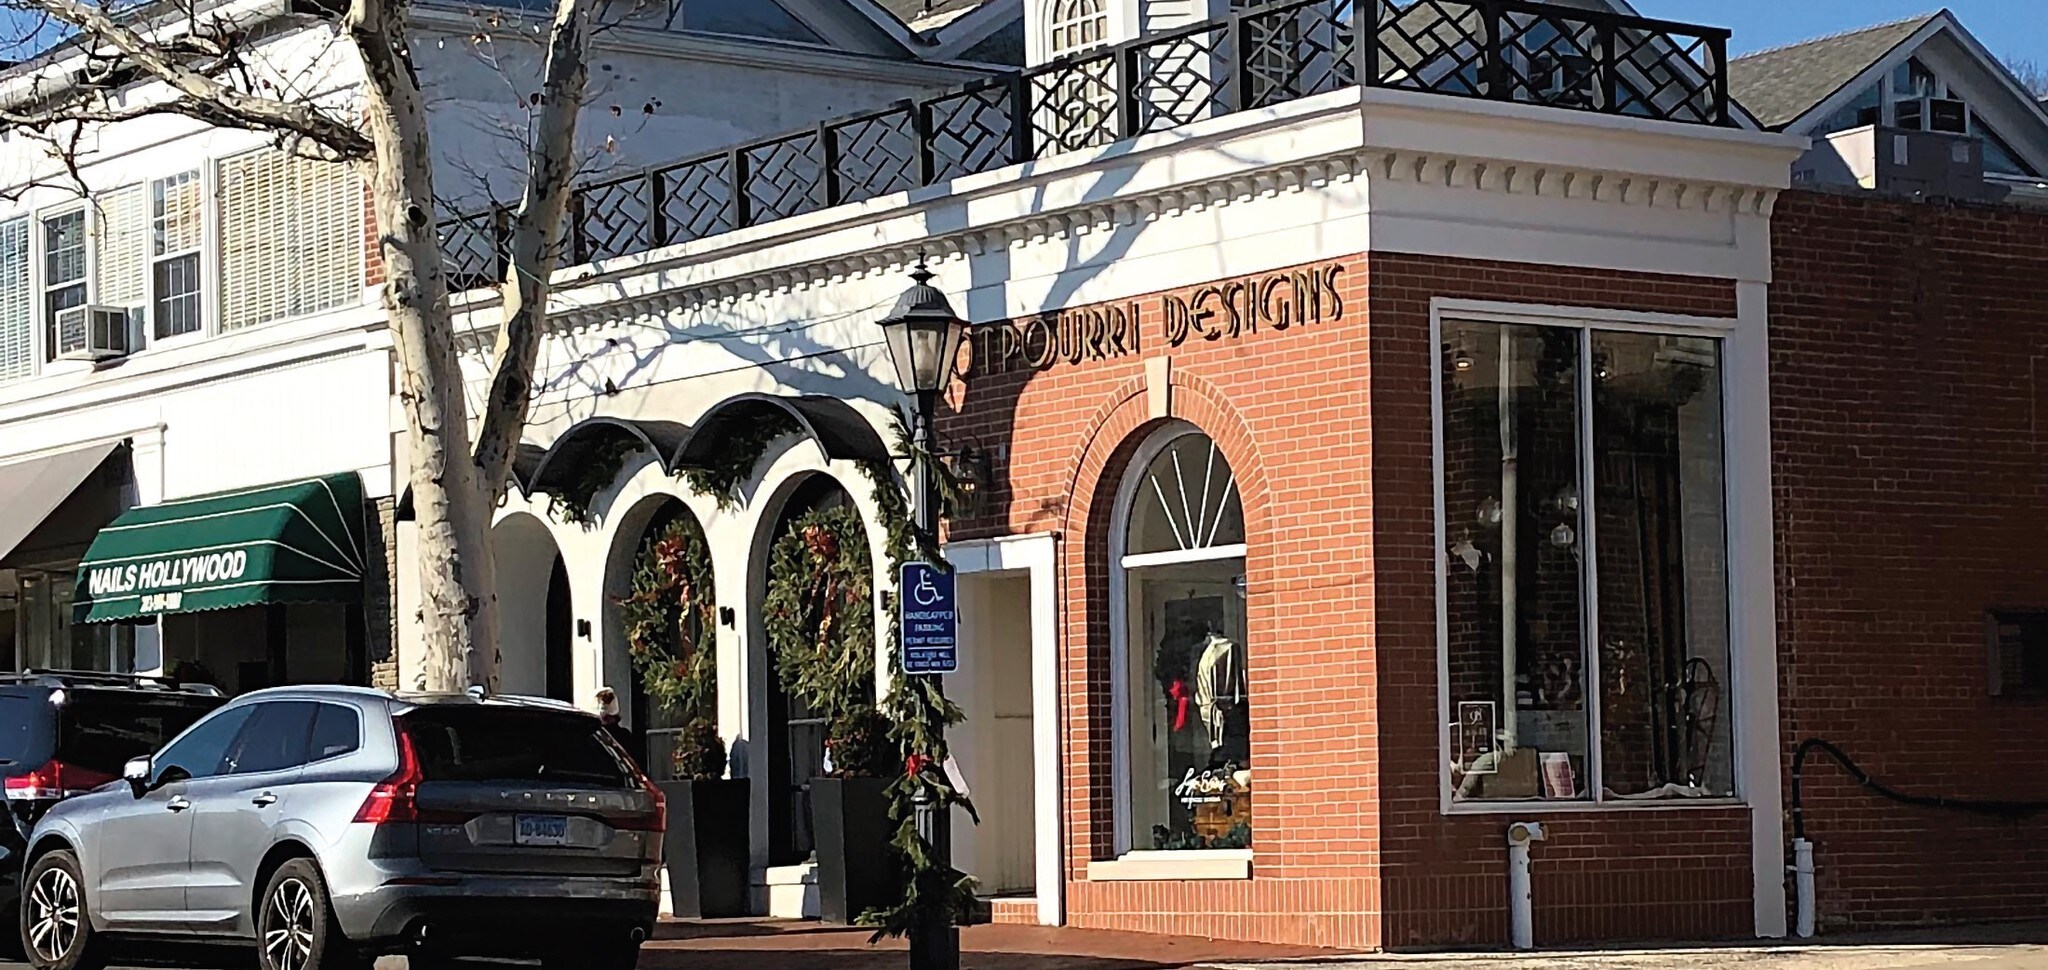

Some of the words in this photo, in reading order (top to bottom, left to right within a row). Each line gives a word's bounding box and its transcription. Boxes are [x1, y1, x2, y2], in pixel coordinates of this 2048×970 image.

[952, 301, 1140, 375] OTPOURRI
[1162, 263, 1345, 347] DESIGNS
[89, 564, 137, 594] NAILS
[138, 550, 246, 589] HOLLYWOOD
[501, 792, 596, 803] VOLVO
